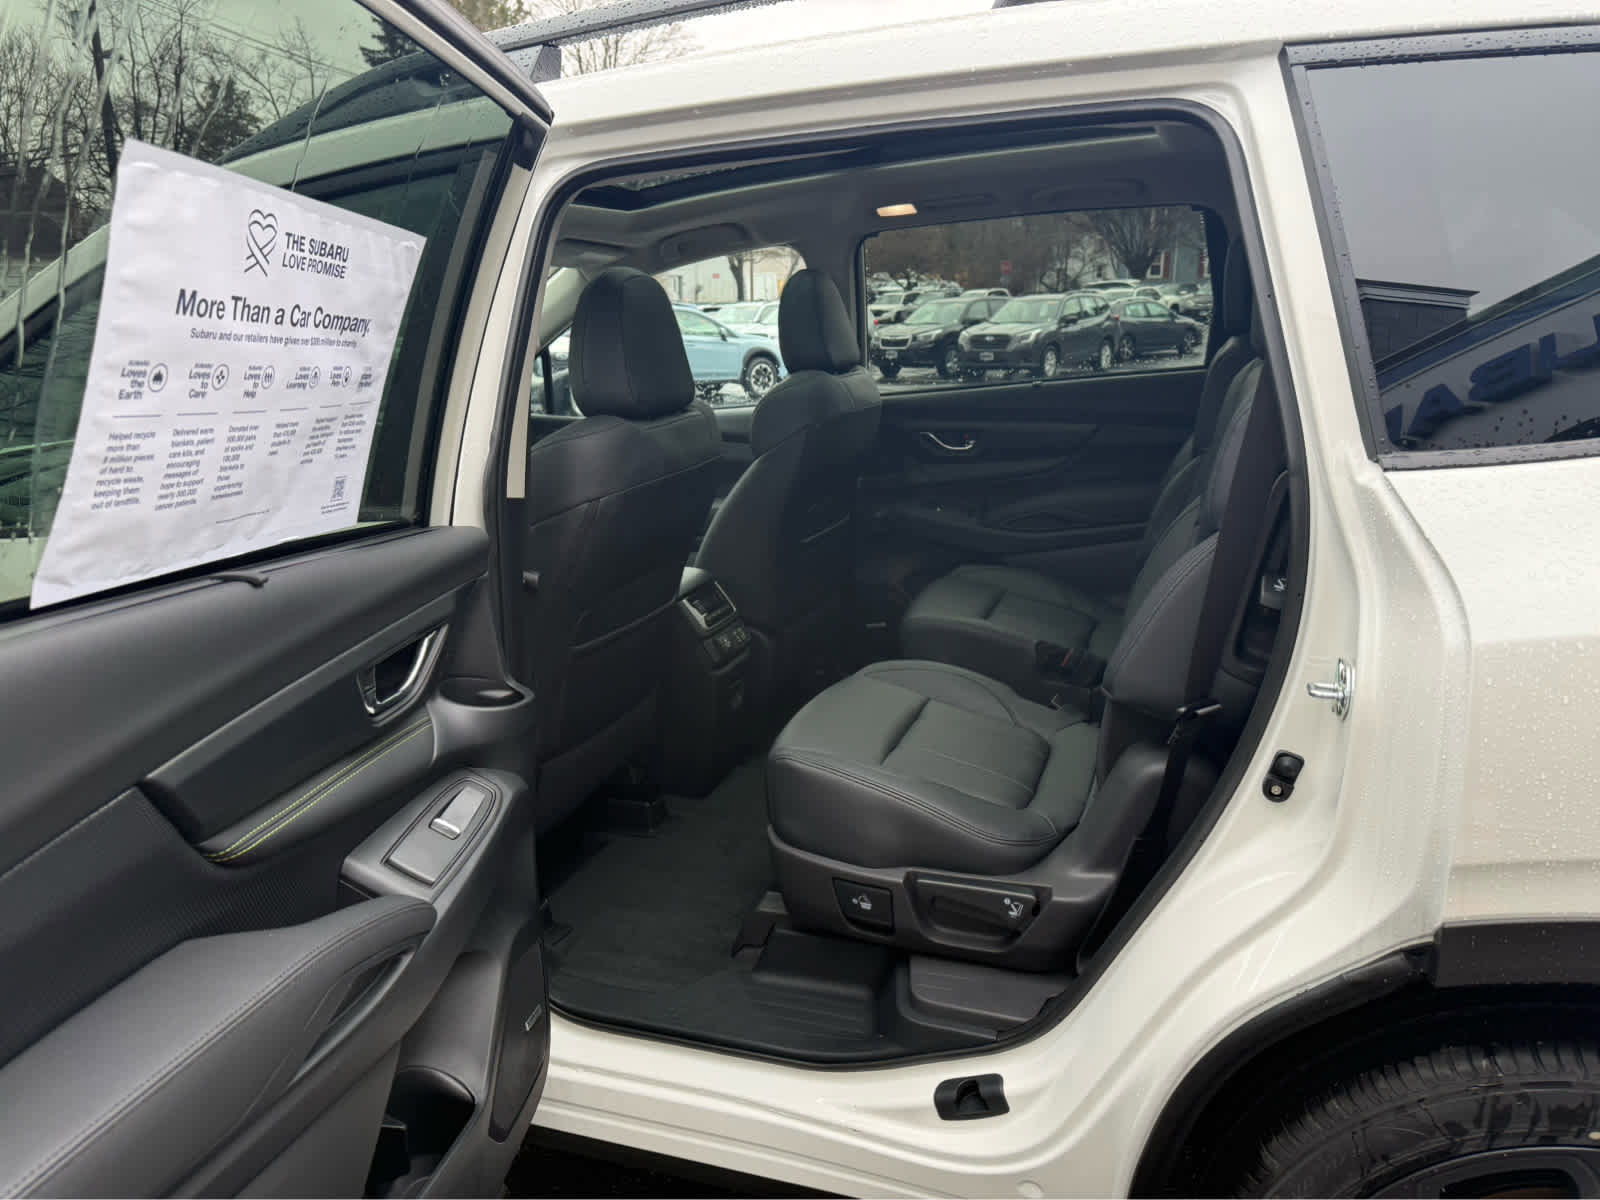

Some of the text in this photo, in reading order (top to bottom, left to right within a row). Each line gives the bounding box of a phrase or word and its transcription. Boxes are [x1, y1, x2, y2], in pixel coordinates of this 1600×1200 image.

[285, 232, 349, 263] THE SUBARU
[282, 252, 347, 279] LOVE PROMISE
[175, 288, 226, 321] More
[231, 295, 271, 325] Than
[274, 308, 285, 326] a
[289, 304, 312, 329] Car
[190, 327, 217, 341] Subaru
[218, 331, 233, 342] and
[233, 334, 244, 343] our
[244, 332, 269, 345] retailers
[269, 334, 284, 345] have
[284, 336, 300, 347] given
[120, 367, 147, 379] Loves
[188, 368, 211, 380] Loves
[243, 371, 261, 381] Loves
[130, 379, 145, 389] the
[200, 381, 209, 390] to
[118, 388, 143, 401] Earth
[188, 388, 208, 399] Care
[108, 430, 156, 441] Helped recycle
[172, 427, 200, 437] Delivered
[106, 444, 124, 452] more
[168, 450, 182, 459] care
[96, 478, 122, 488] recycle
[93, 488, 122, 499] keeping
